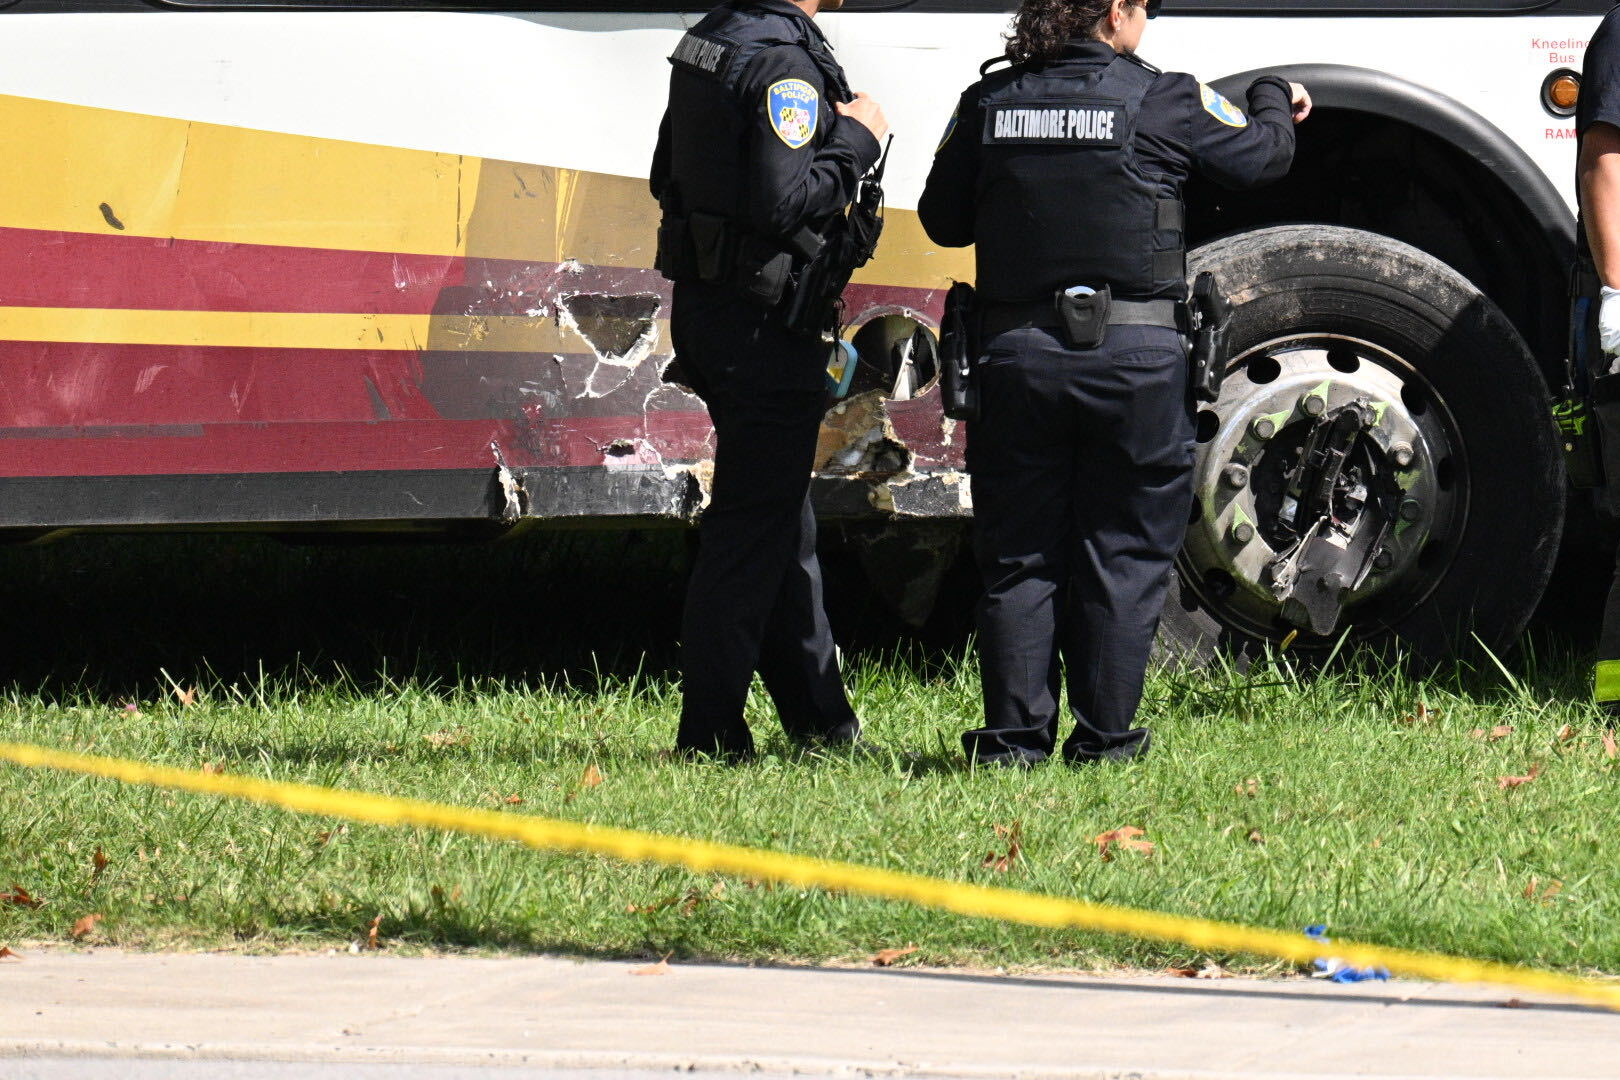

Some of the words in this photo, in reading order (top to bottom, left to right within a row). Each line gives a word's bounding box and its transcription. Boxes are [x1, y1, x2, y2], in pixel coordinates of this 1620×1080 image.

[1549, 52, 1575, 63] Bus
[774, 82, 816, 101] BALTIMORE
[782, 91, 810, 104] POLICE
[994, 110, 1065, 138] BALTIMORE
[1067, 110, 1114, 139] POLICE
[1545, 128, 1578, 139] RAM
